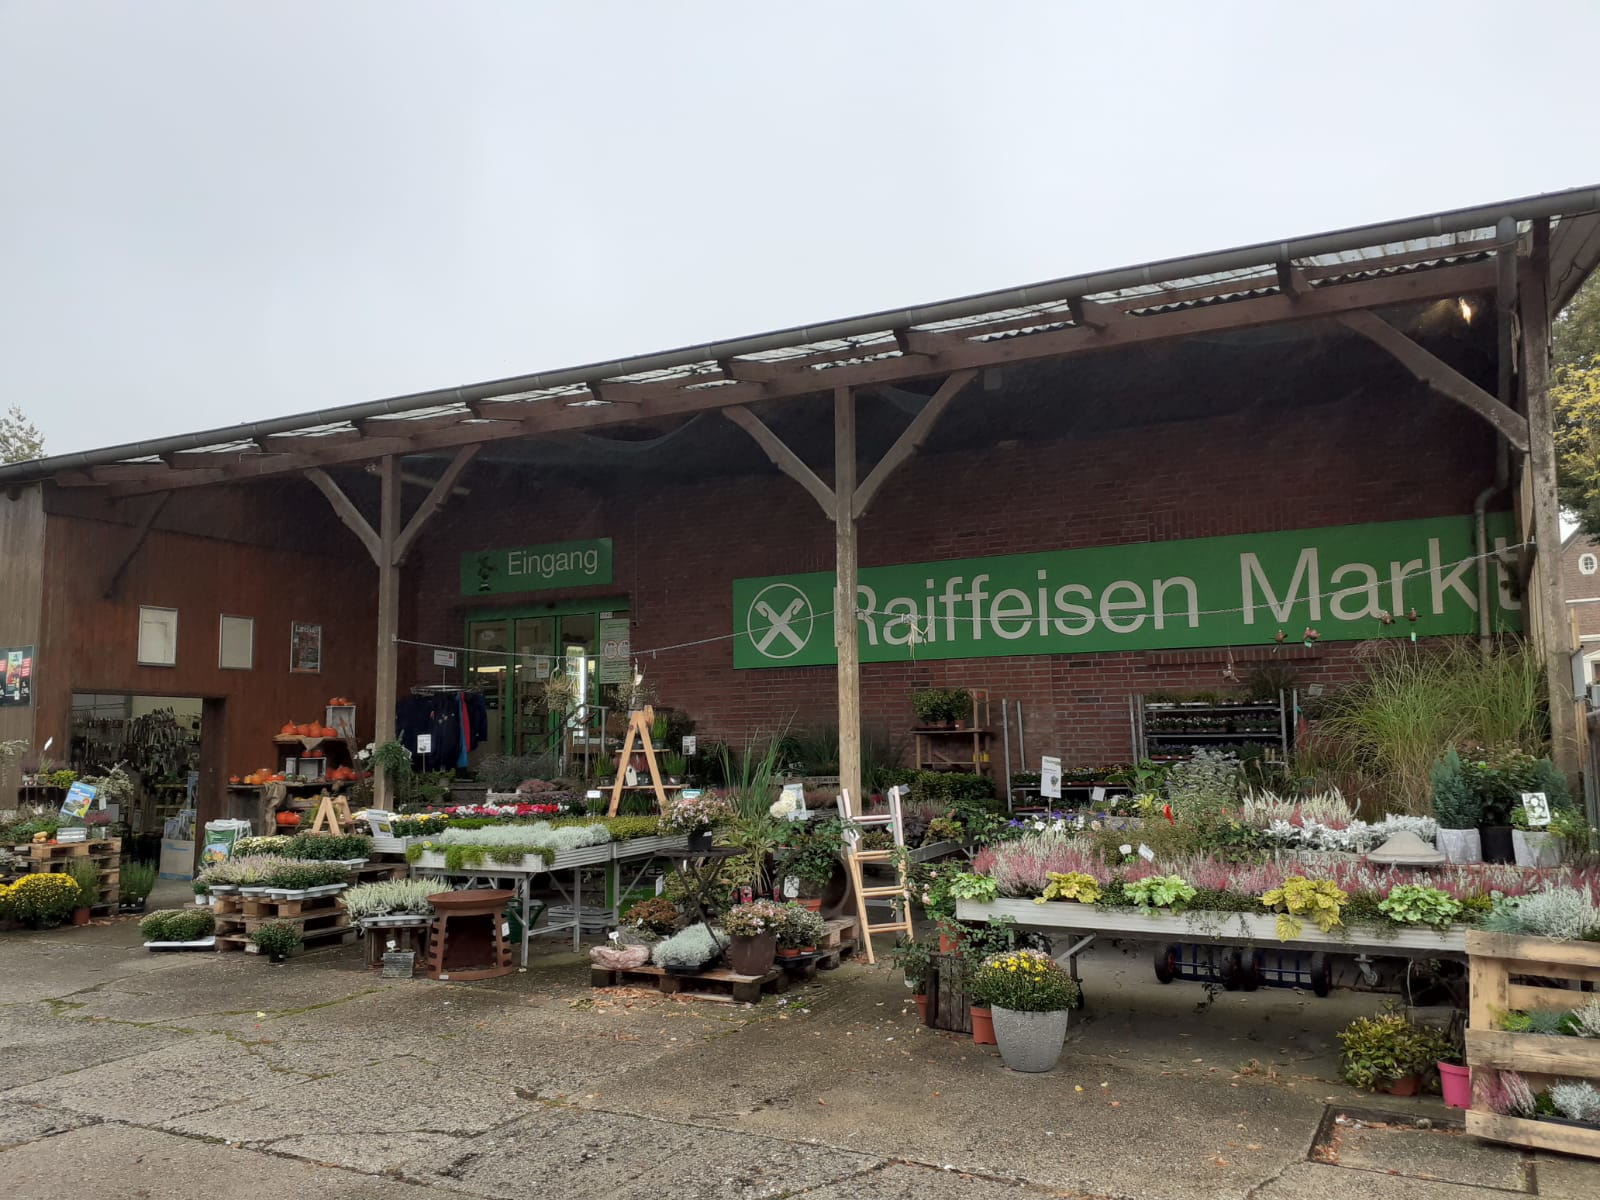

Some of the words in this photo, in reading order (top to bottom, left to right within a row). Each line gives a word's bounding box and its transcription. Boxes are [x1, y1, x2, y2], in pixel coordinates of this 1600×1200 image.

[508, 549, 598, 578] Eingang
[833, 569, 1199, 648] Raiffeisen
[1240, 537, 1521, 625] Markt
